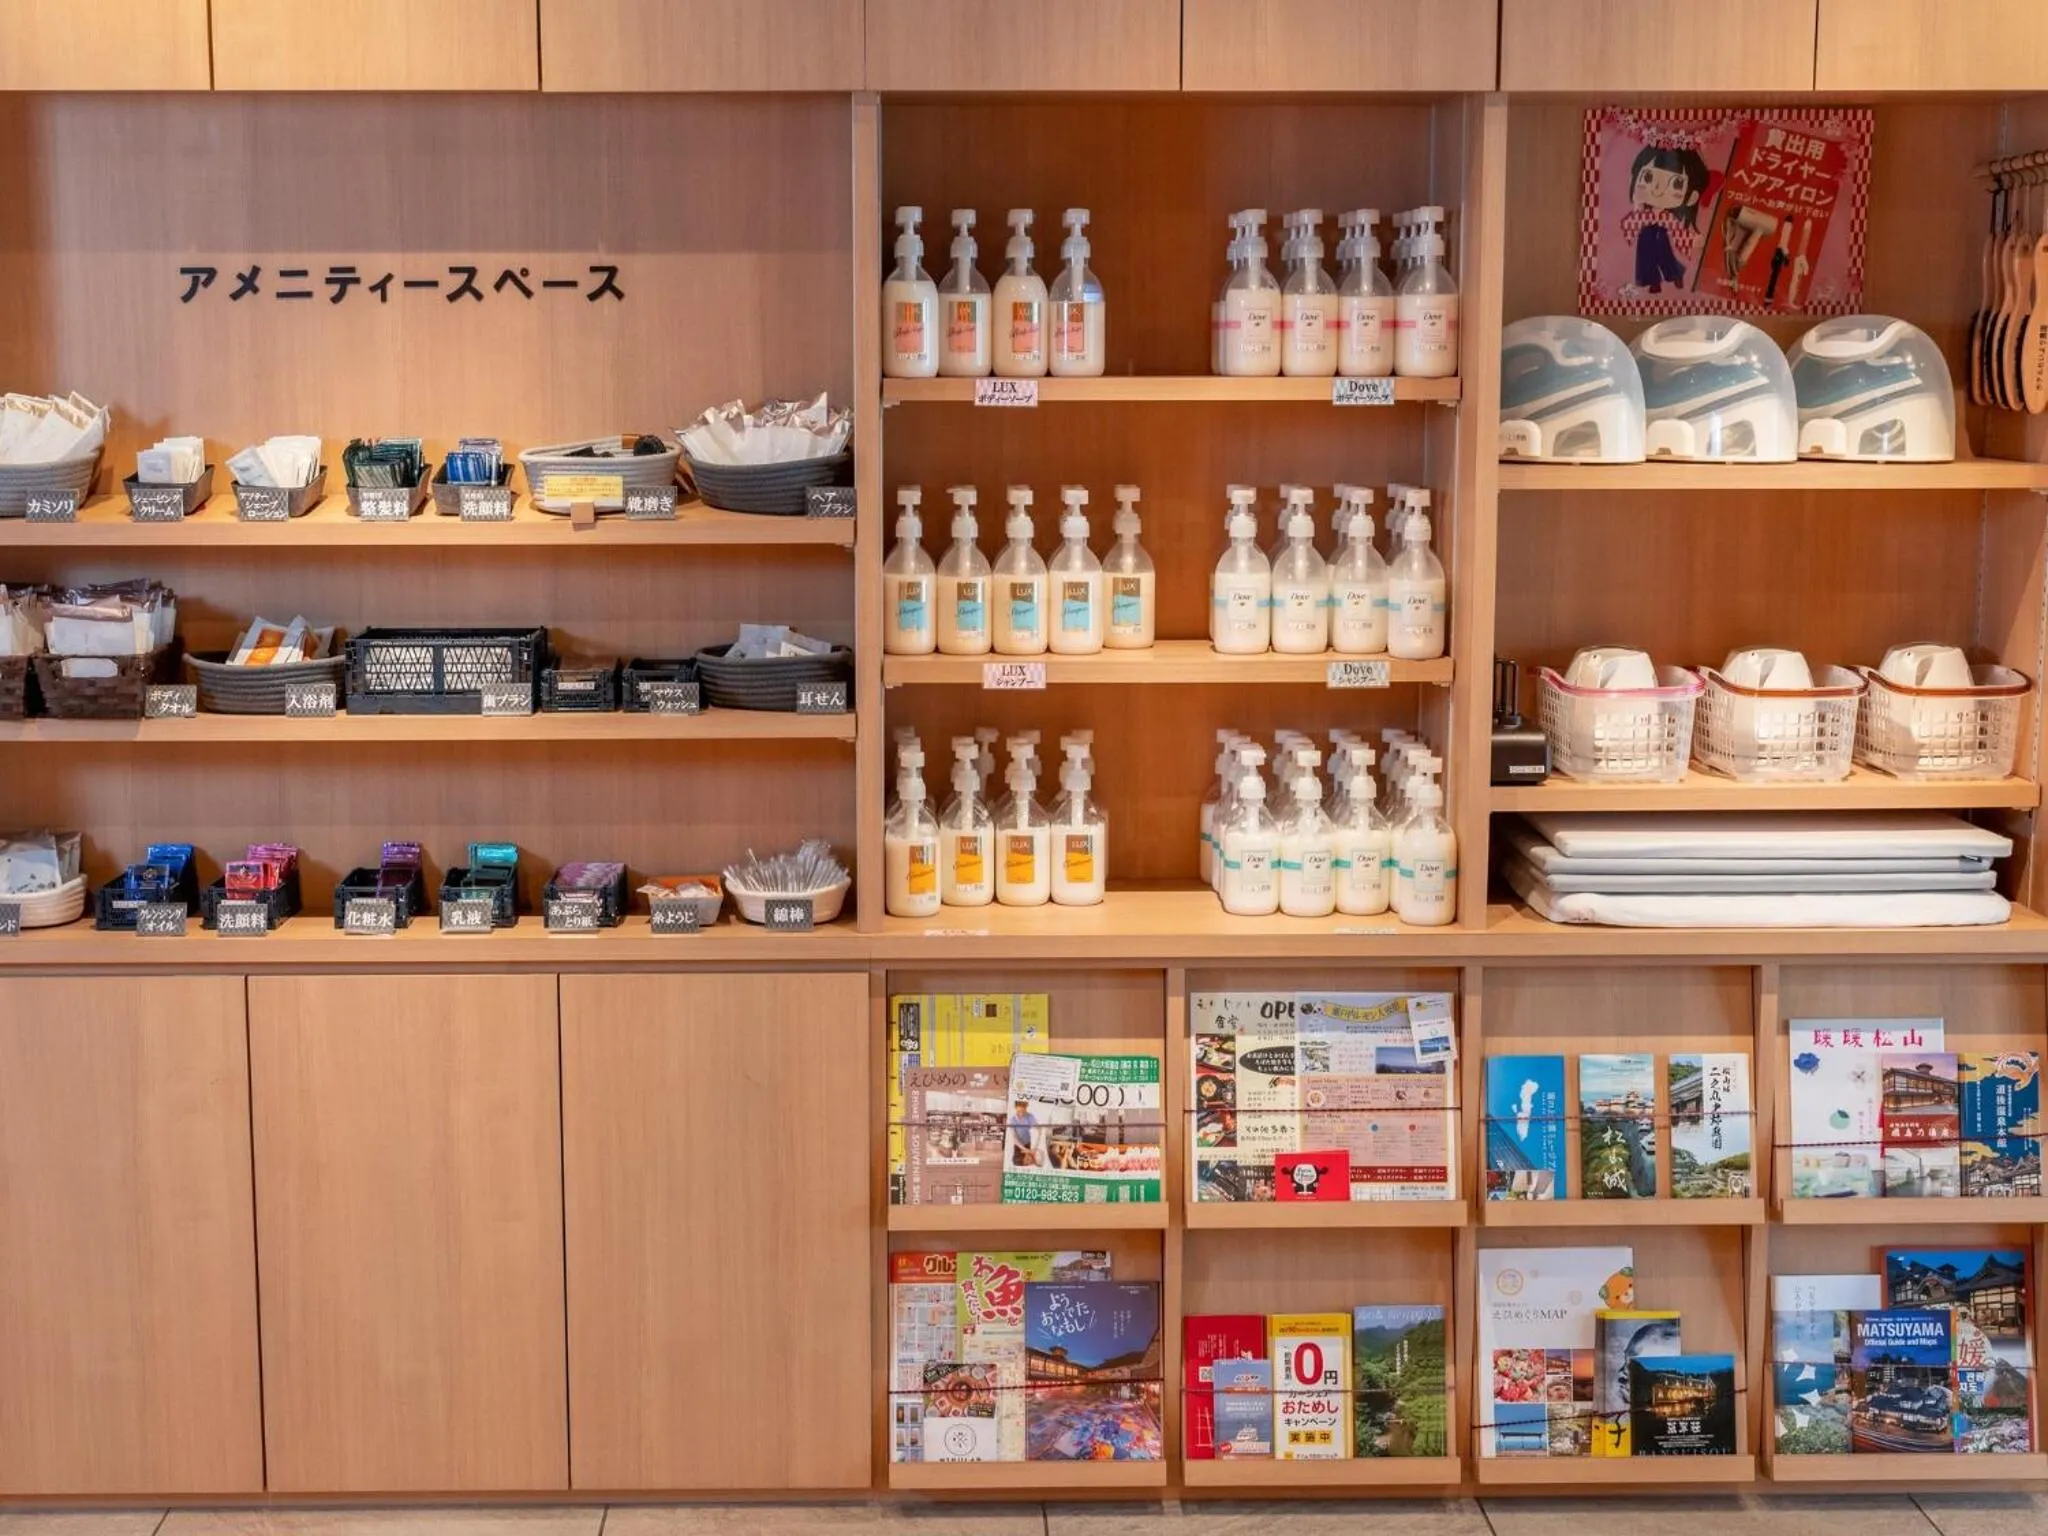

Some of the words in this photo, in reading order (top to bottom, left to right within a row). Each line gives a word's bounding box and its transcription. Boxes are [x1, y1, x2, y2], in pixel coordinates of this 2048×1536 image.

[1764, 128, 1827, 162] 貸出用
[1750, 147, 1833, 181] ドライヤー
[1733, 167, 1835, 207] ヘアアイロン
[180, 264, 626, 304] アメニティースペース
[992, 382, 1017, 393] LUX
[1349, 381, 1379, 393] Dove
[811, 491, 837, 503] ヘア
[27, 499, 75, 514] カミソリ
[140, 505, 175, 516] クリーム
[360, 500, 409, 516] 整髪料
[463, 501, 510, 517] 洗顔料
[627, 497, 673, 512] 靴磨き
[822, 502, 853, 514] ブラシ
[1001, 665, 1026, 676] LUX
[1344, 663, 1373, 676] Dove
[484, 692, 531, 707] 歯ブラシ
[653, 688, 683, 698] マウス
[799, 691, 845, 707] 耳せん
[159, 702, 194, 714] タオル
[286, 694, 335, 709] 入浴剤
[551, 905, 581, 915] あぶら
[652, 910, 695, 924] 糸ようじ
[220, 913, 266, 929] 洗顔料
[347, 910, 393, 927] 化粧水
[450, 910, 483, 925] 乳液
[564, 916, 593, 928] とり紙
[145, 920, 176, 932] オイル
[1813, 1028, 1924, 1048] 暖暖松山
[910, 1073, 968, 1087] えひめの
[1857, 1322, 1944, 1337] MATSUYAMA
[1907, 1338, 1919, 1346] and
[1282, 1400, 1339, 1414] おためし
[1283, 1417, 1337, 1427] キャンペーン
[1289, 1432, 1331, 1444] 実施中
